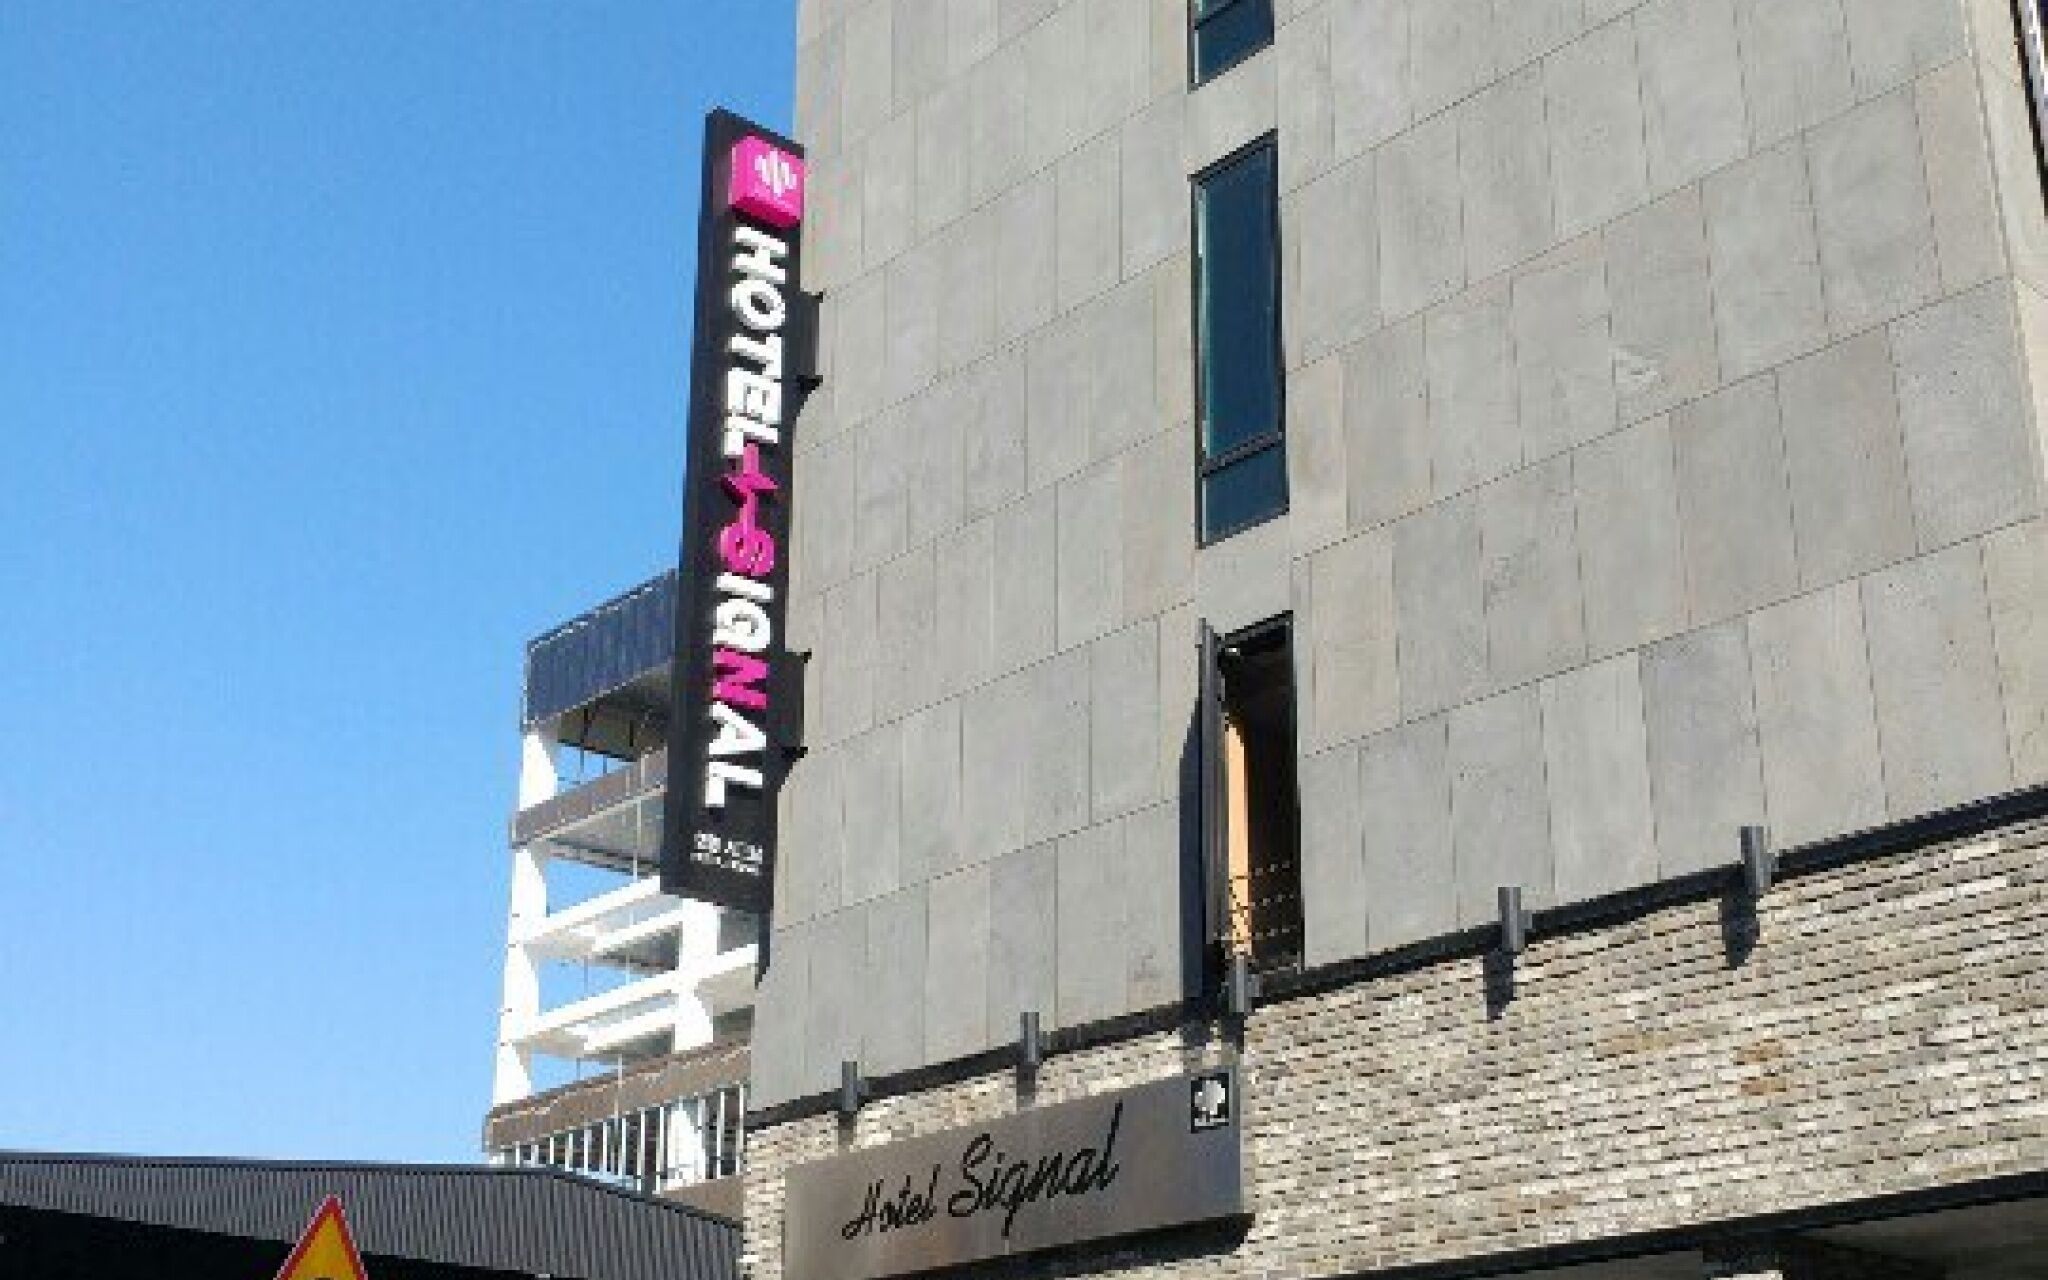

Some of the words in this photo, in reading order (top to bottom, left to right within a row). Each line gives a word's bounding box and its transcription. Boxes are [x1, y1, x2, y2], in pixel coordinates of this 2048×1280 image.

[723, 224, 789, 456] HOTEL
[705, 521, 776, 808] SIGNAL
[841, 1163, 941, 1240] Hotel
[947, 1101, 1124, 1237] Signal
